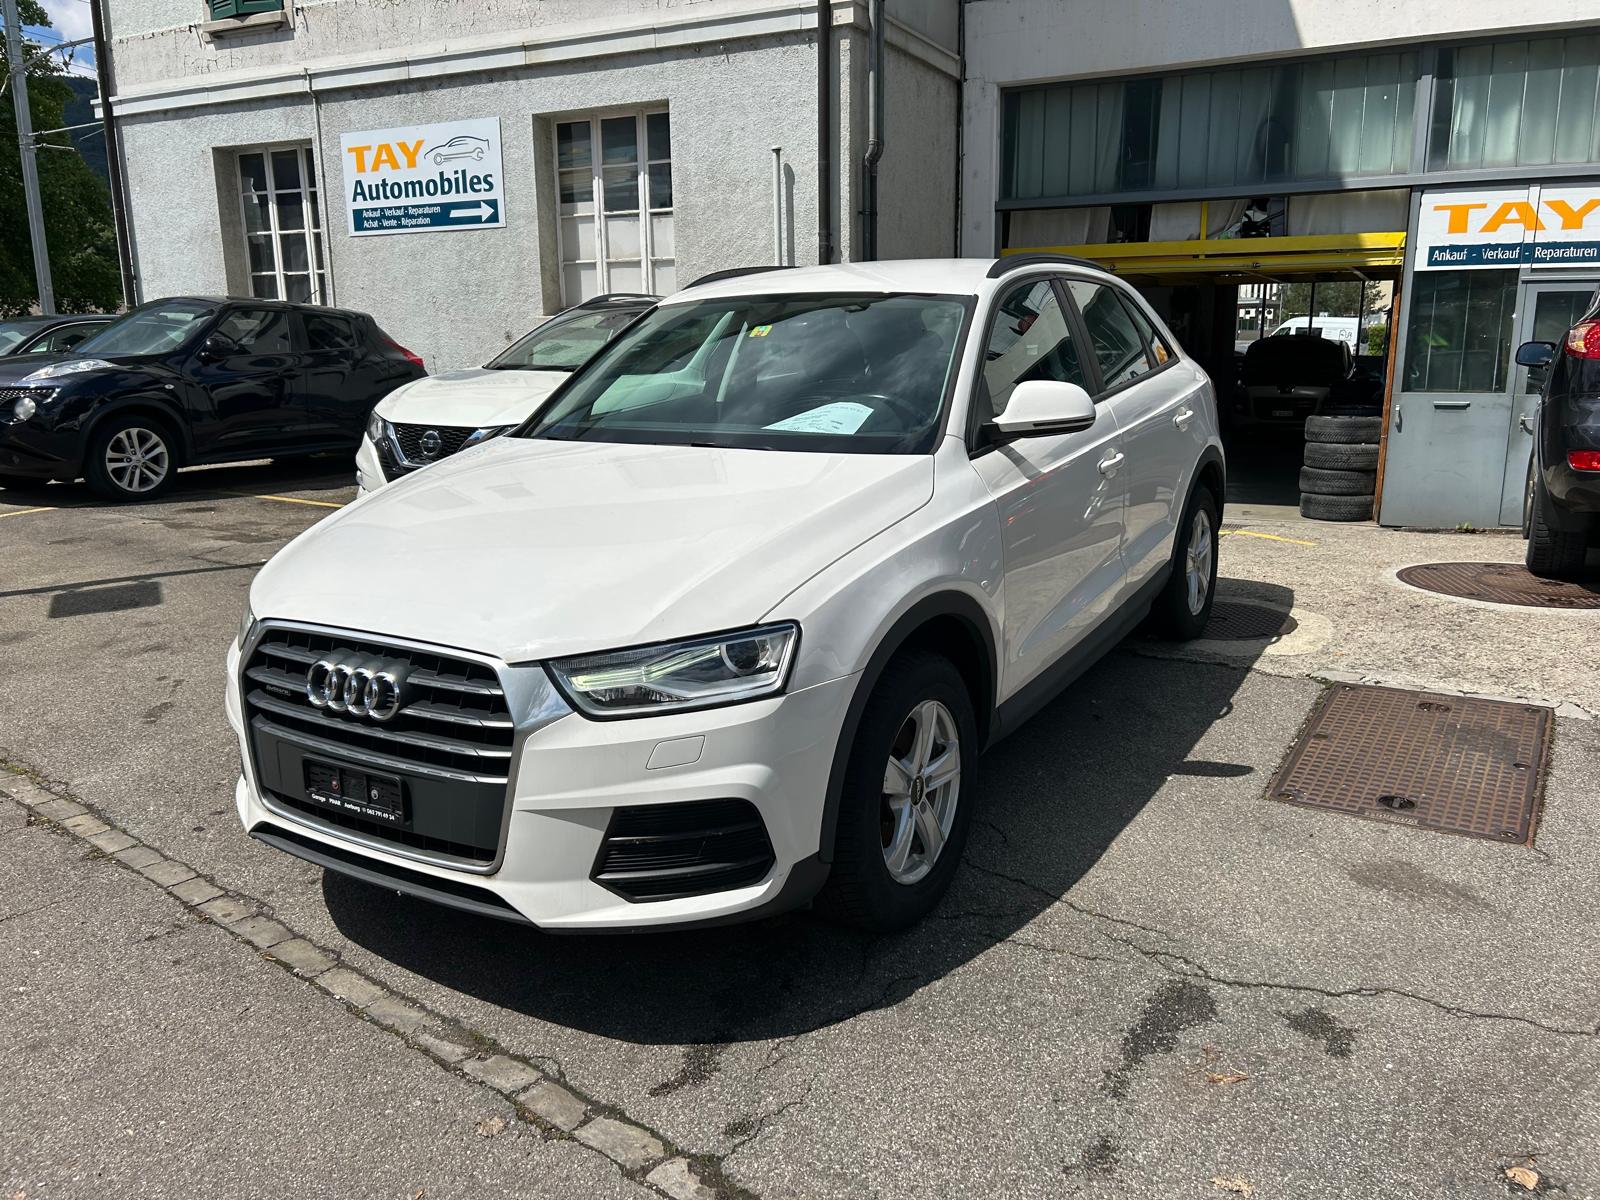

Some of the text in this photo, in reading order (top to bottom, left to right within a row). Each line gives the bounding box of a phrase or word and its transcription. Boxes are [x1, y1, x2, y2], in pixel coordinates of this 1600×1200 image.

[347, 139, 425, 174] TAY
[352, 168, 494, 203] Automobiles
[362, 208, 381, 218] Ankauf
[384, 206, 405, 217] Verkauf
[408, 205, 441, 216] Reparaturen
[363, 219, 379, 228] Achat
[382, 219, 398, 227] Vente
[1433, 198, 1600, 234] TAY
[1432, 248, 1467, 261] Ankauf
[1482, 246, 1520, 260] Verkauf
[1534, 246, 1597, 261] Reparaturen
